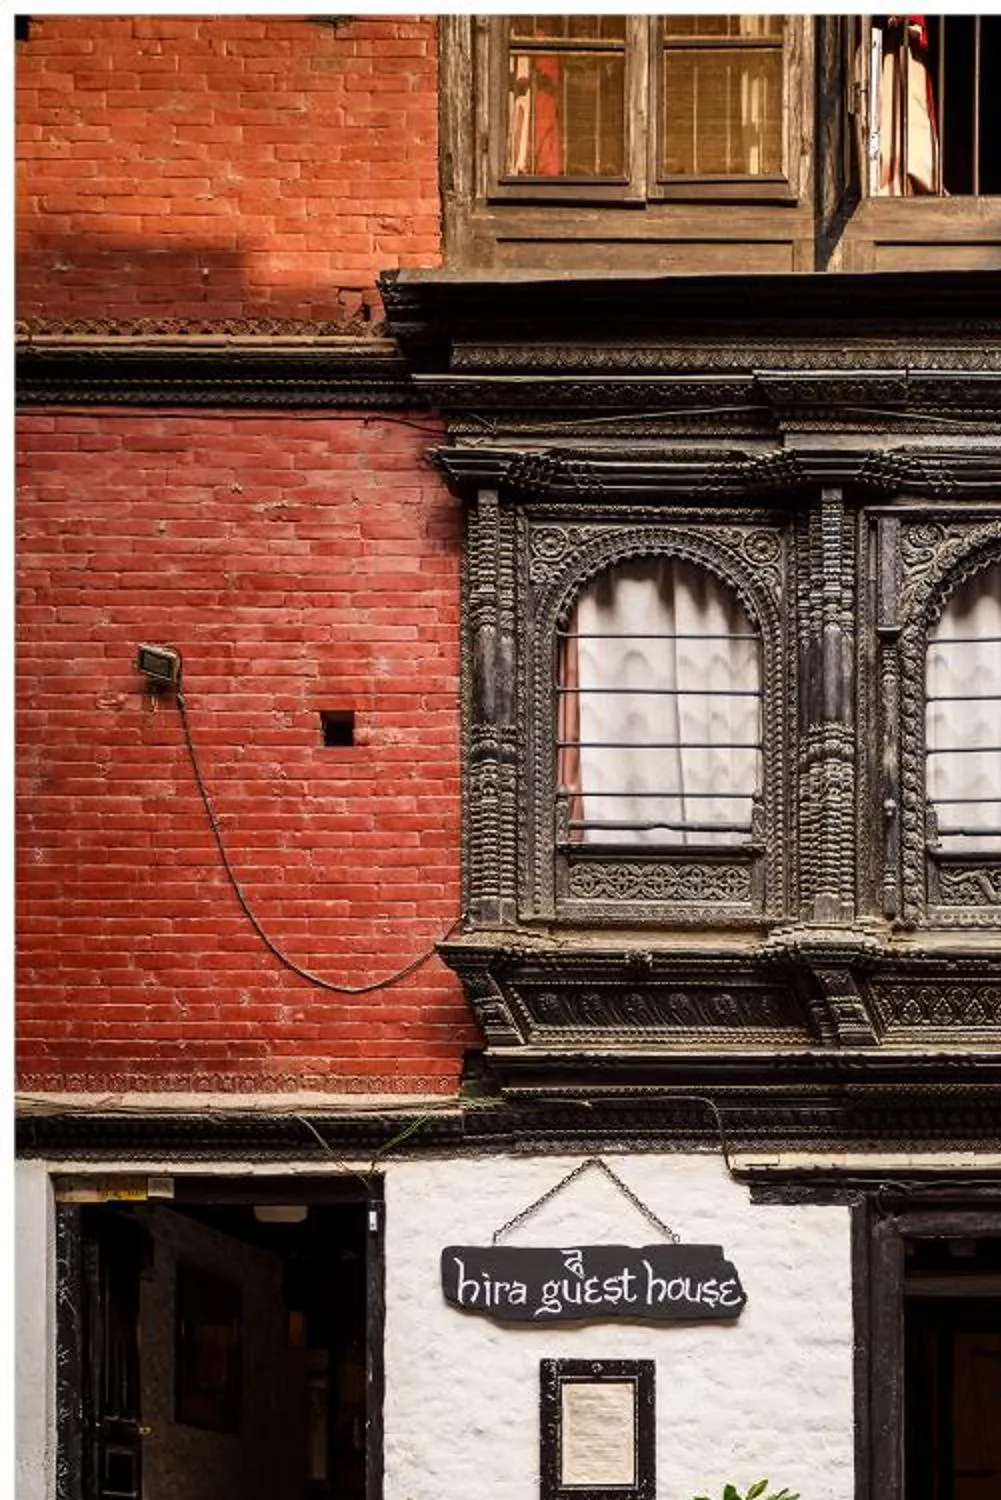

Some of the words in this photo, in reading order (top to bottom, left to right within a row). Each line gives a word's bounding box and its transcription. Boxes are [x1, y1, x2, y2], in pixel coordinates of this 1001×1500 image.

[453, 1257, 527, 1307] hira
[533, 1267, 638, 1317] guest
[642, 1260, 743, 1308] house
